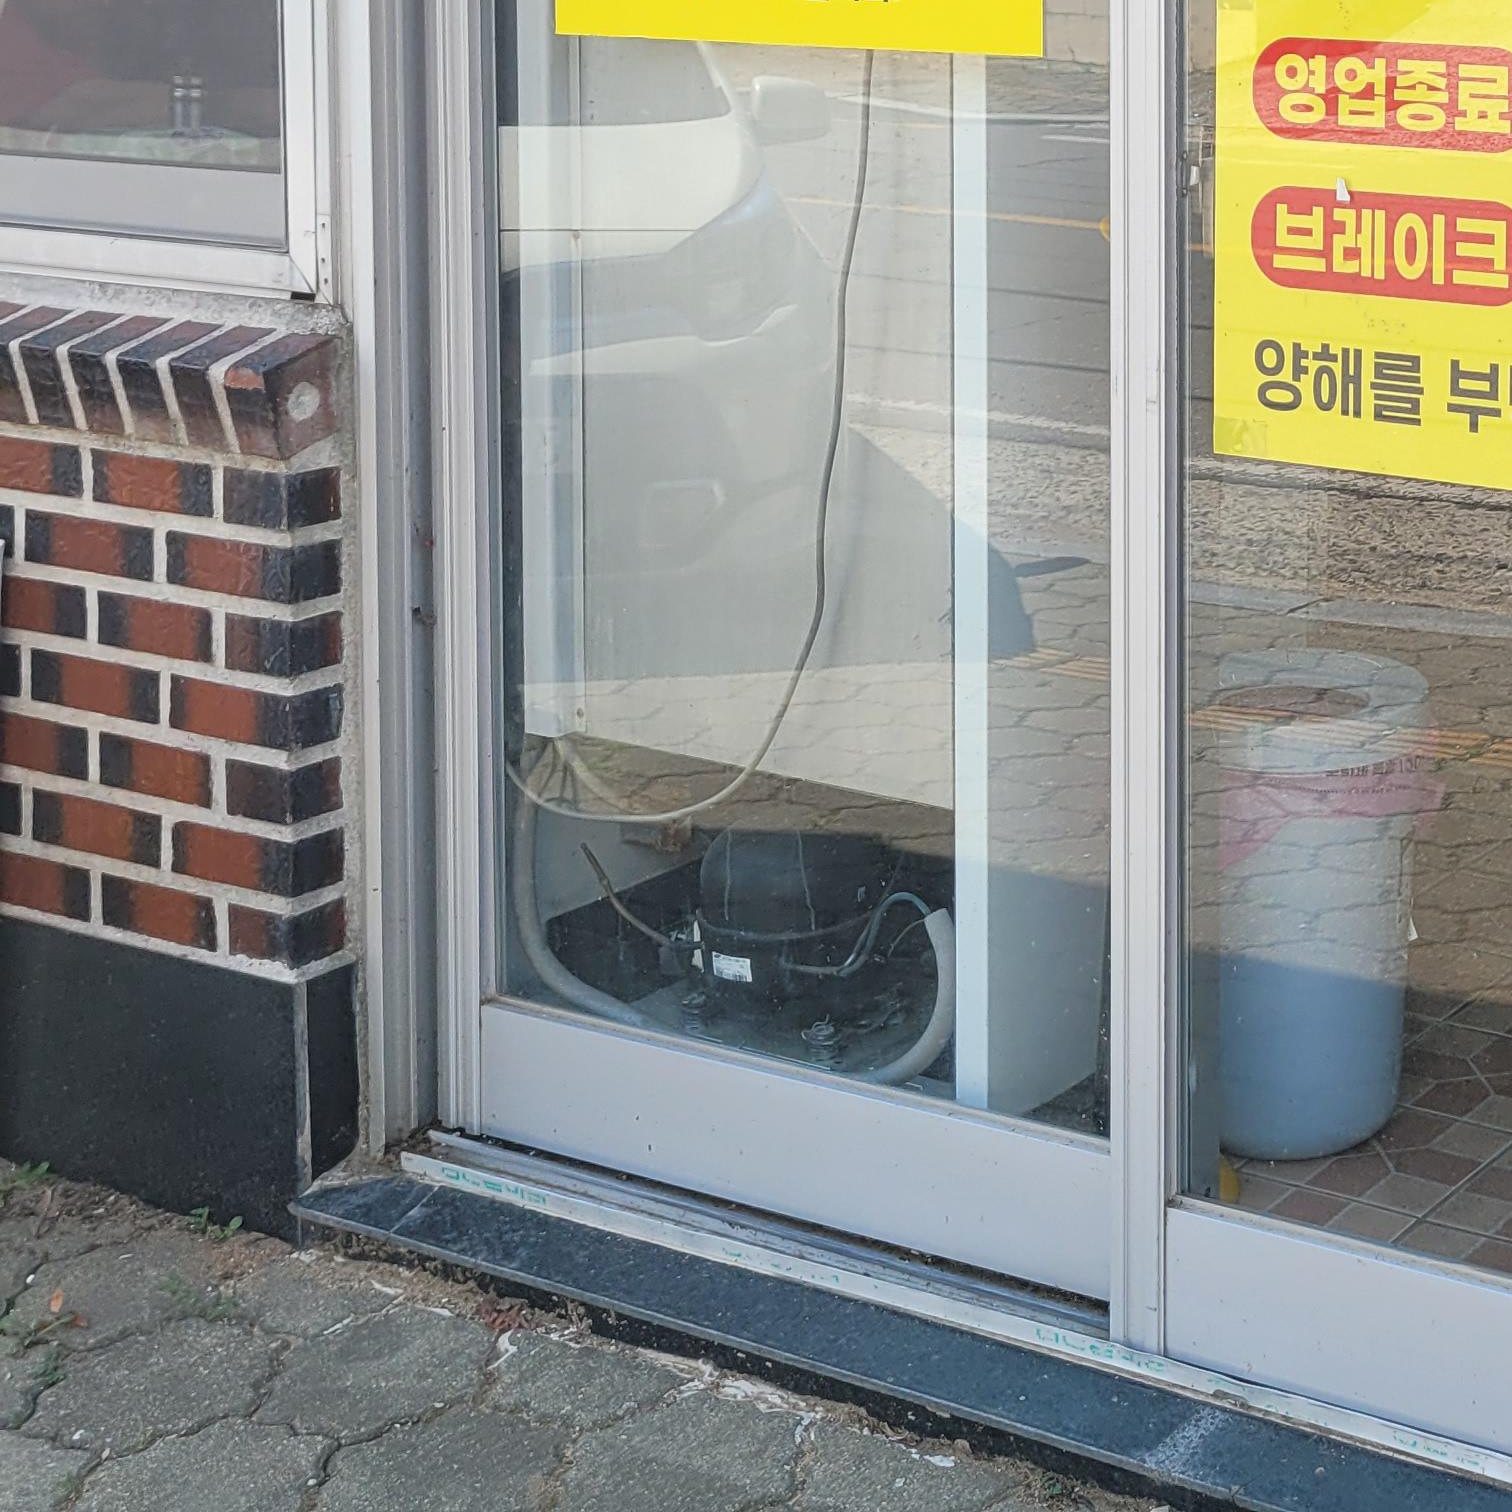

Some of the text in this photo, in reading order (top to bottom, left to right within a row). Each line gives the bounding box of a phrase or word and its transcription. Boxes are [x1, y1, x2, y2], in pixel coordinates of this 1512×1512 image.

[1274, 53, 1512, 136] 영업종료
[1273, 204, 1512, 288] 브레이크
[1255, 340, 1424, 426] 양해를
